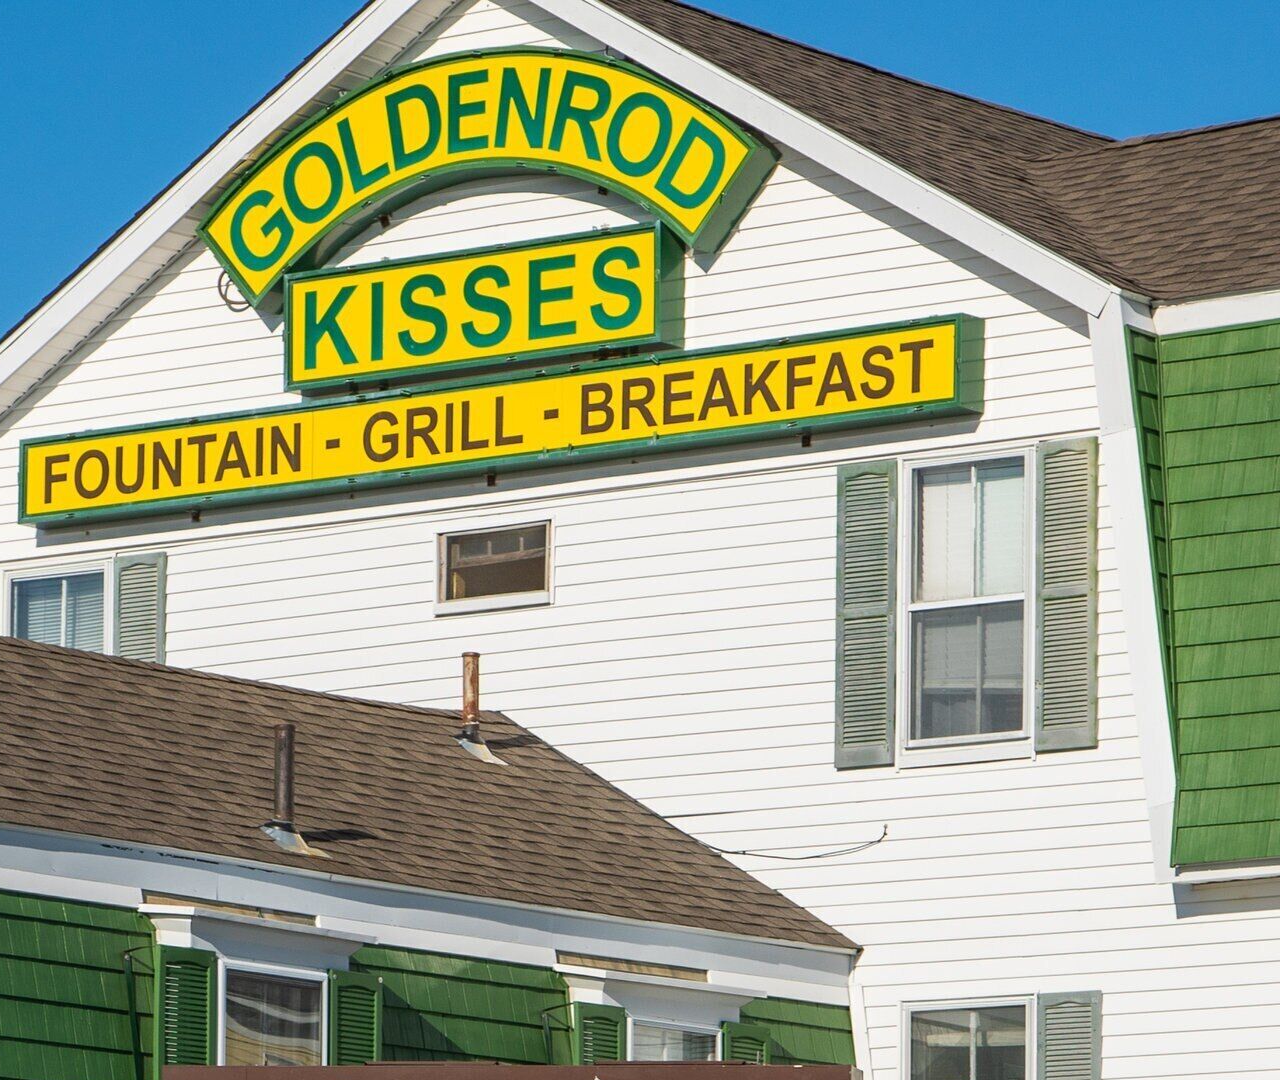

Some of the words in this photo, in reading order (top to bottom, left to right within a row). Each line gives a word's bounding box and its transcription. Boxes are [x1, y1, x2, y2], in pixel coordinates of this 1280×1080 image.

[230, 68, 725, 272] GOLDENROD
[304, 247, 642, 369] KISSES
[43, 422, 302, 505] FOUNTAIN
[362, 395, 524, 463] GRILL
[580, 338, 934, 436] BREAKFAST
